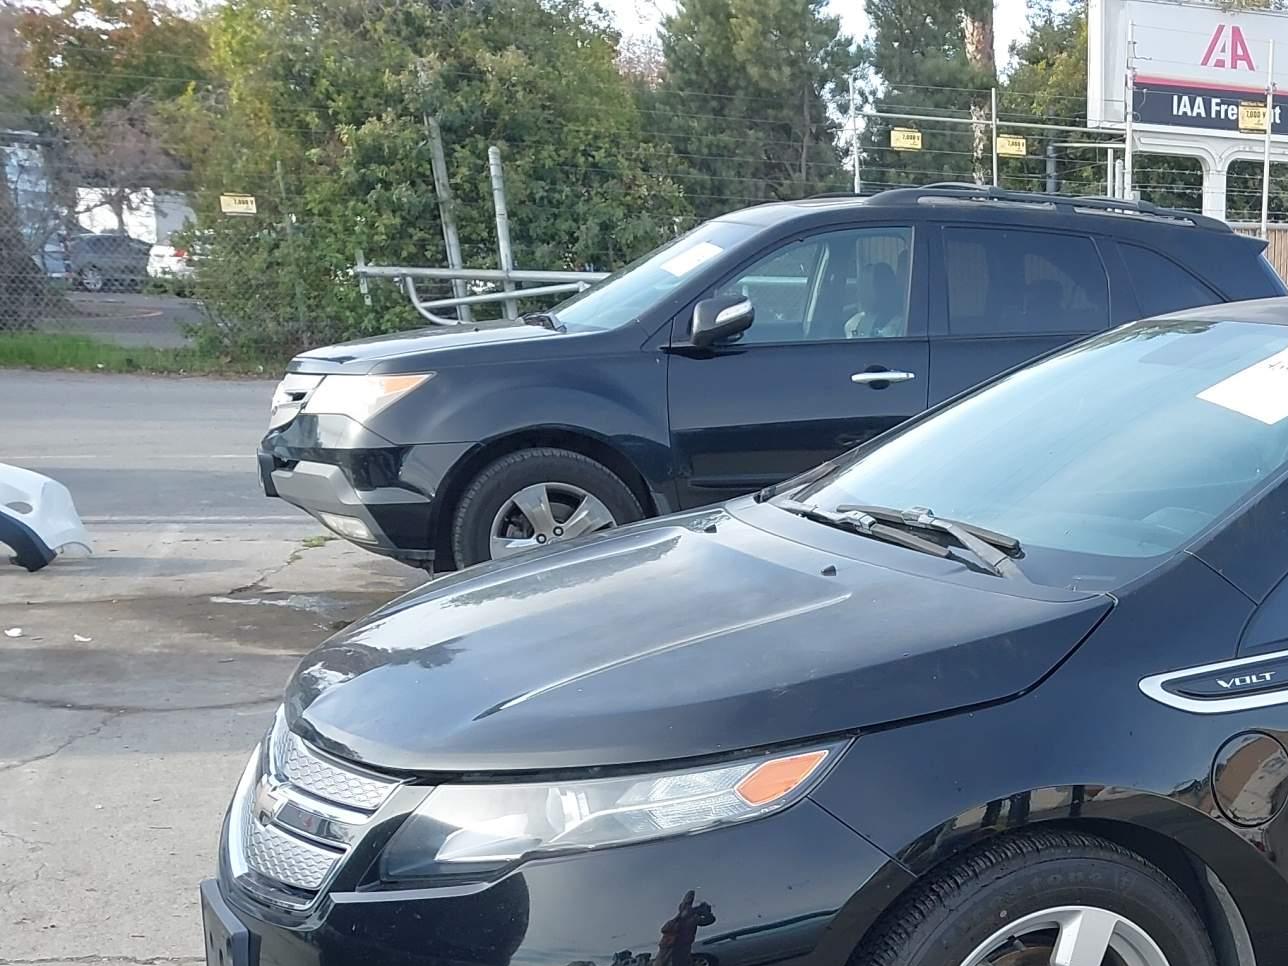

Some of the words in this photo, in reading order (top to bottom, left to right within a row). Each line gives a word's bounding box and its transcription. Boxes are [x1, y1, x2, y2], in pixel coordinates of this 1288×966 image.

[1172, 94, 1206, 118] IAA
[1211, 97, 1281, 124] Fret
[1216, 671, 1276, 688] VOLT
